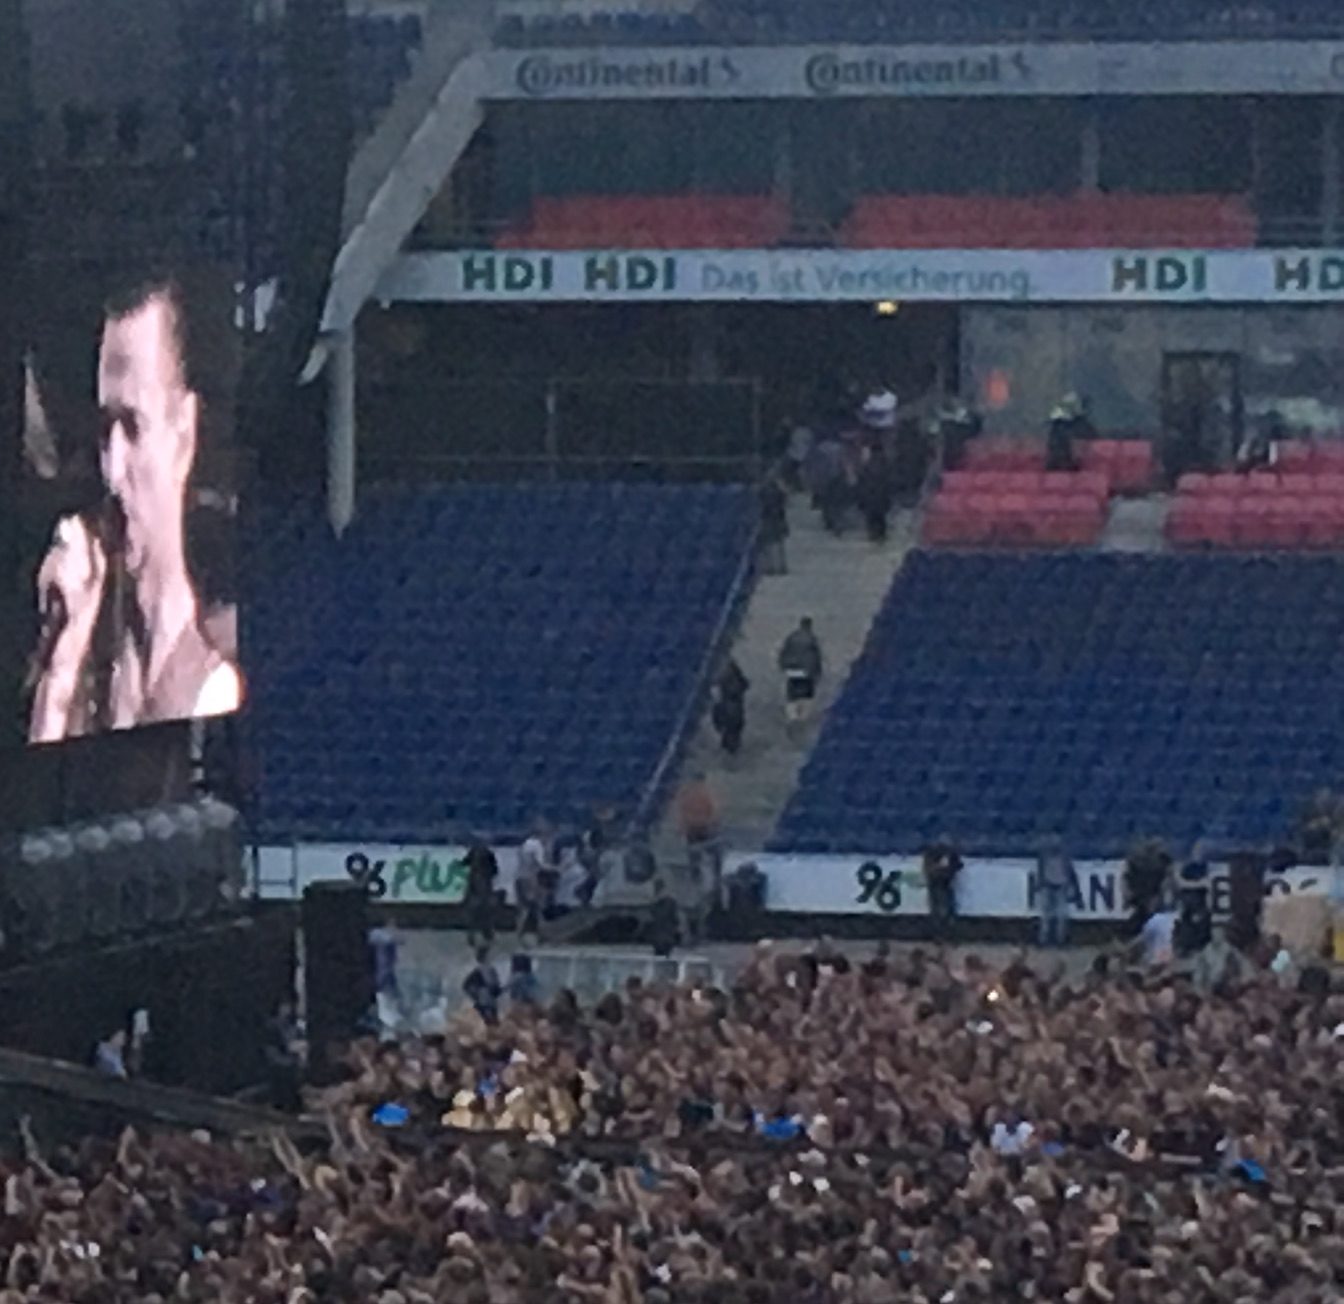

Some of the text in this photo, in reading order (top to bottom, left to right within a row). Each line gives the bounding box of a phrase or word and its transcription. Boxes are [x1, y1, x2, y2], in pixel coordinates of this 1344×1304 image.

[516, 54, 709, 95] Continental
[805, 53, 999, 93] Continental
[463, 256, 553, 291] HDI
[584, 256, 676, 291] HDI
[702, 264, 759, 293] Das
[771, 262, 804, 291] ist
[1113, 256, 1207, 292] HDI
[856, 861, 902, 911] 96
